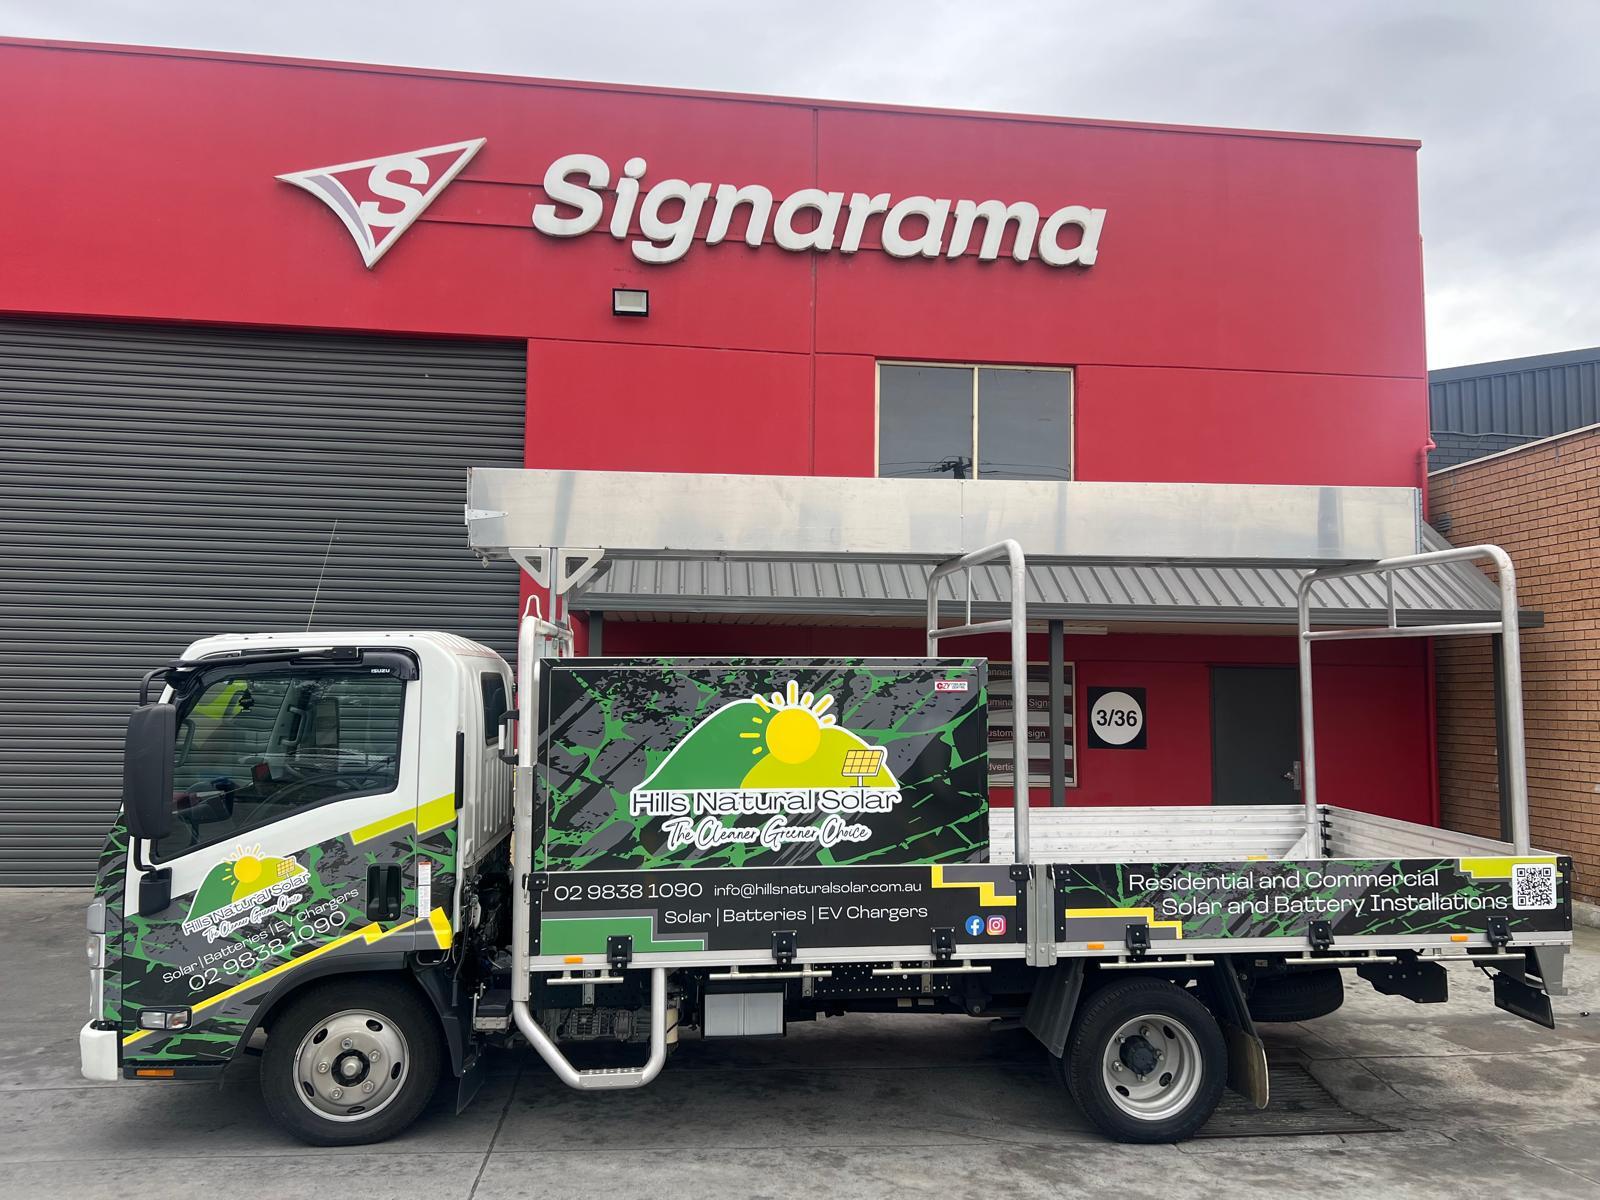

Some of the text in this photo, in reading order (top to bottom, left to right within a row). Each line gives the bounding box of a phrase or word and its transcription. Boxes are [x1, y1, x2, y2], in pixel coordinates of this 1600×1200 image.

[531, 153, 1107, 267] Signarama
[1028, 698, 1050, 708] Sign
[1096, 709, 1138, 727] 3/36
[988, 729, 1046, 740] ustom sign
[632, 789, 899, 813] Hills Natural Solar
[664, 817, 869, 849] The Cleaner Greener Choice
[553, 881, 922, 901] 02 9838 1090 info@hillsnaturalsolar.com.au
[1129, 869, 1439, 891] Residential and Commercial
[184, 873, 310, 934] Hills Natural Solar
[664, 908, 712, 924] Solar
[723, 907, 807, 923] Batteries
[818, 906, 843, 920] EV
[846, 904, 929, 922] Chargers
[1162, 892, 1508, 917] Solar and Battery Installations
[162, 961, 198, 984] Solar
[203, 930, 268, 965] Batteries
[275, 916, 294, 933] EV
[296, 888, 360, 922] Chargers
[188, 910, 346, 991] 02 9838 1090
